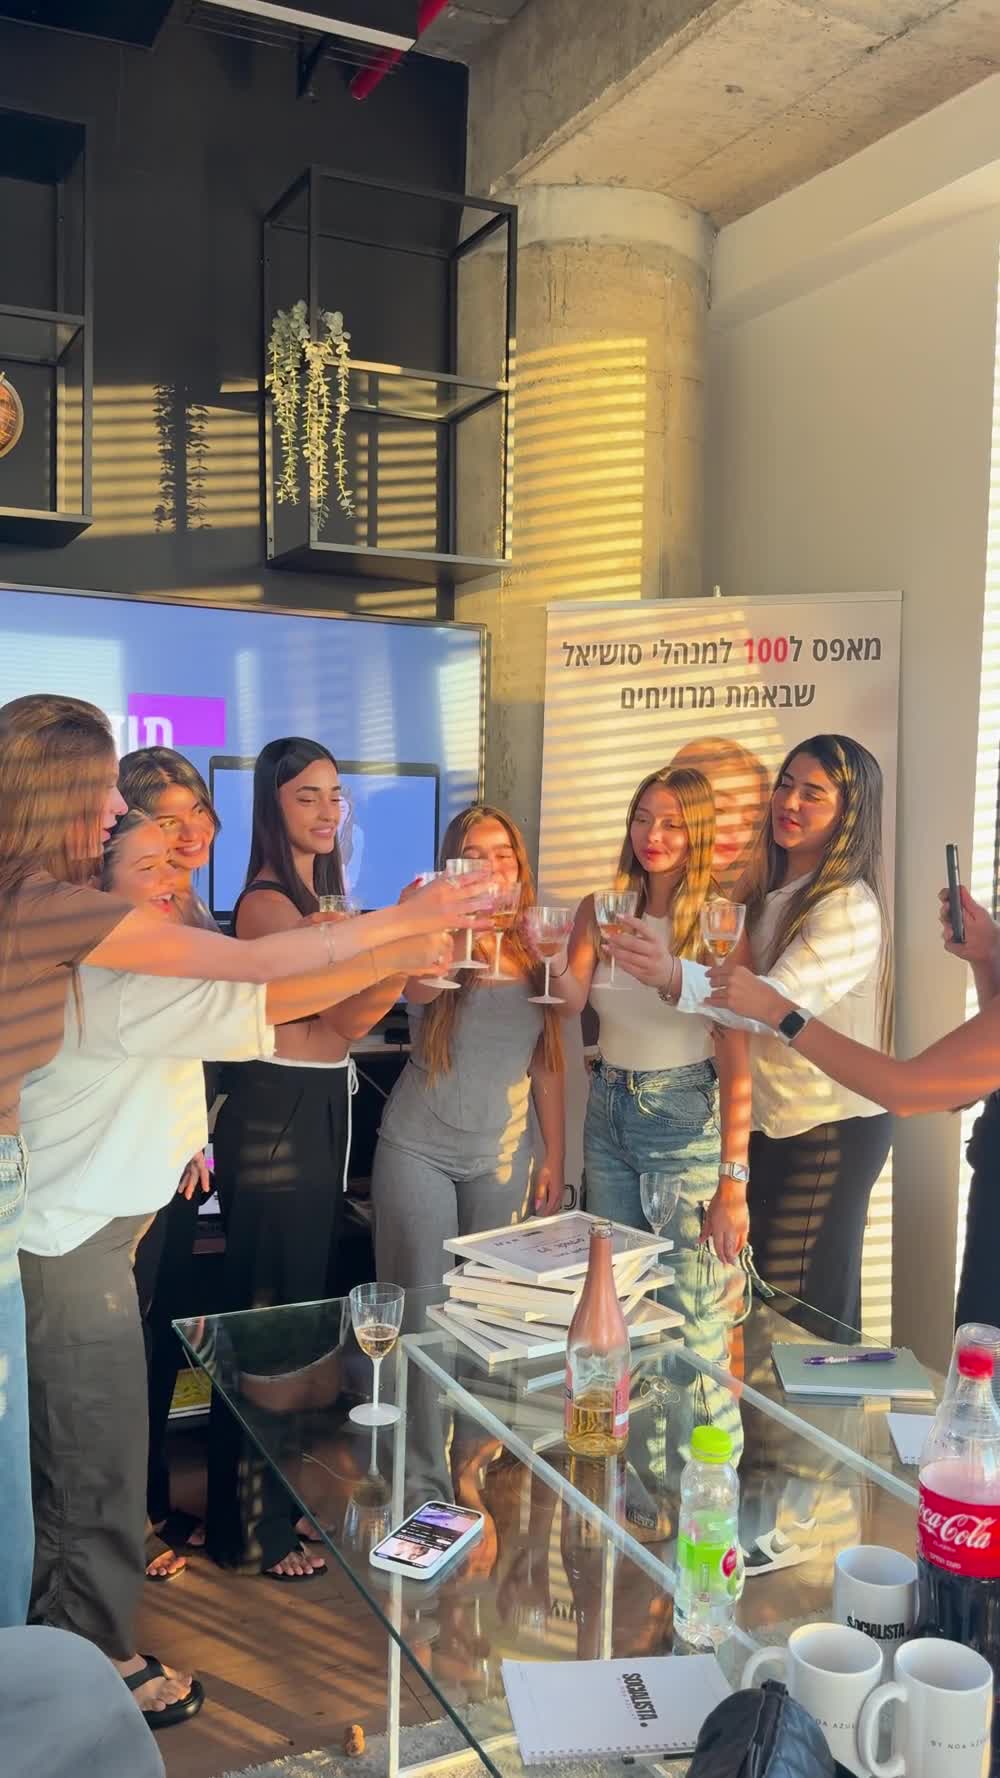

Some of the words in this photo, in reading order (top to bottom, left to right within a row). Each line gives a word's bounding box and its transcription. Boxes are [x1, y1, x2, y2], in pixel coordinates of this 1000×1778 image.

[562, 641, 643, 667] סושיאל
[652, 637, 733, 665] למנהלי
[743, 636, 802, 664] ל100
[811, 636, 882, 662] מאפס
[620, 684, 715, 709] מרוויחים
[725, 683, 816, 709] שבאמת
[918, 1494, 998, 1549] oca-Cola
